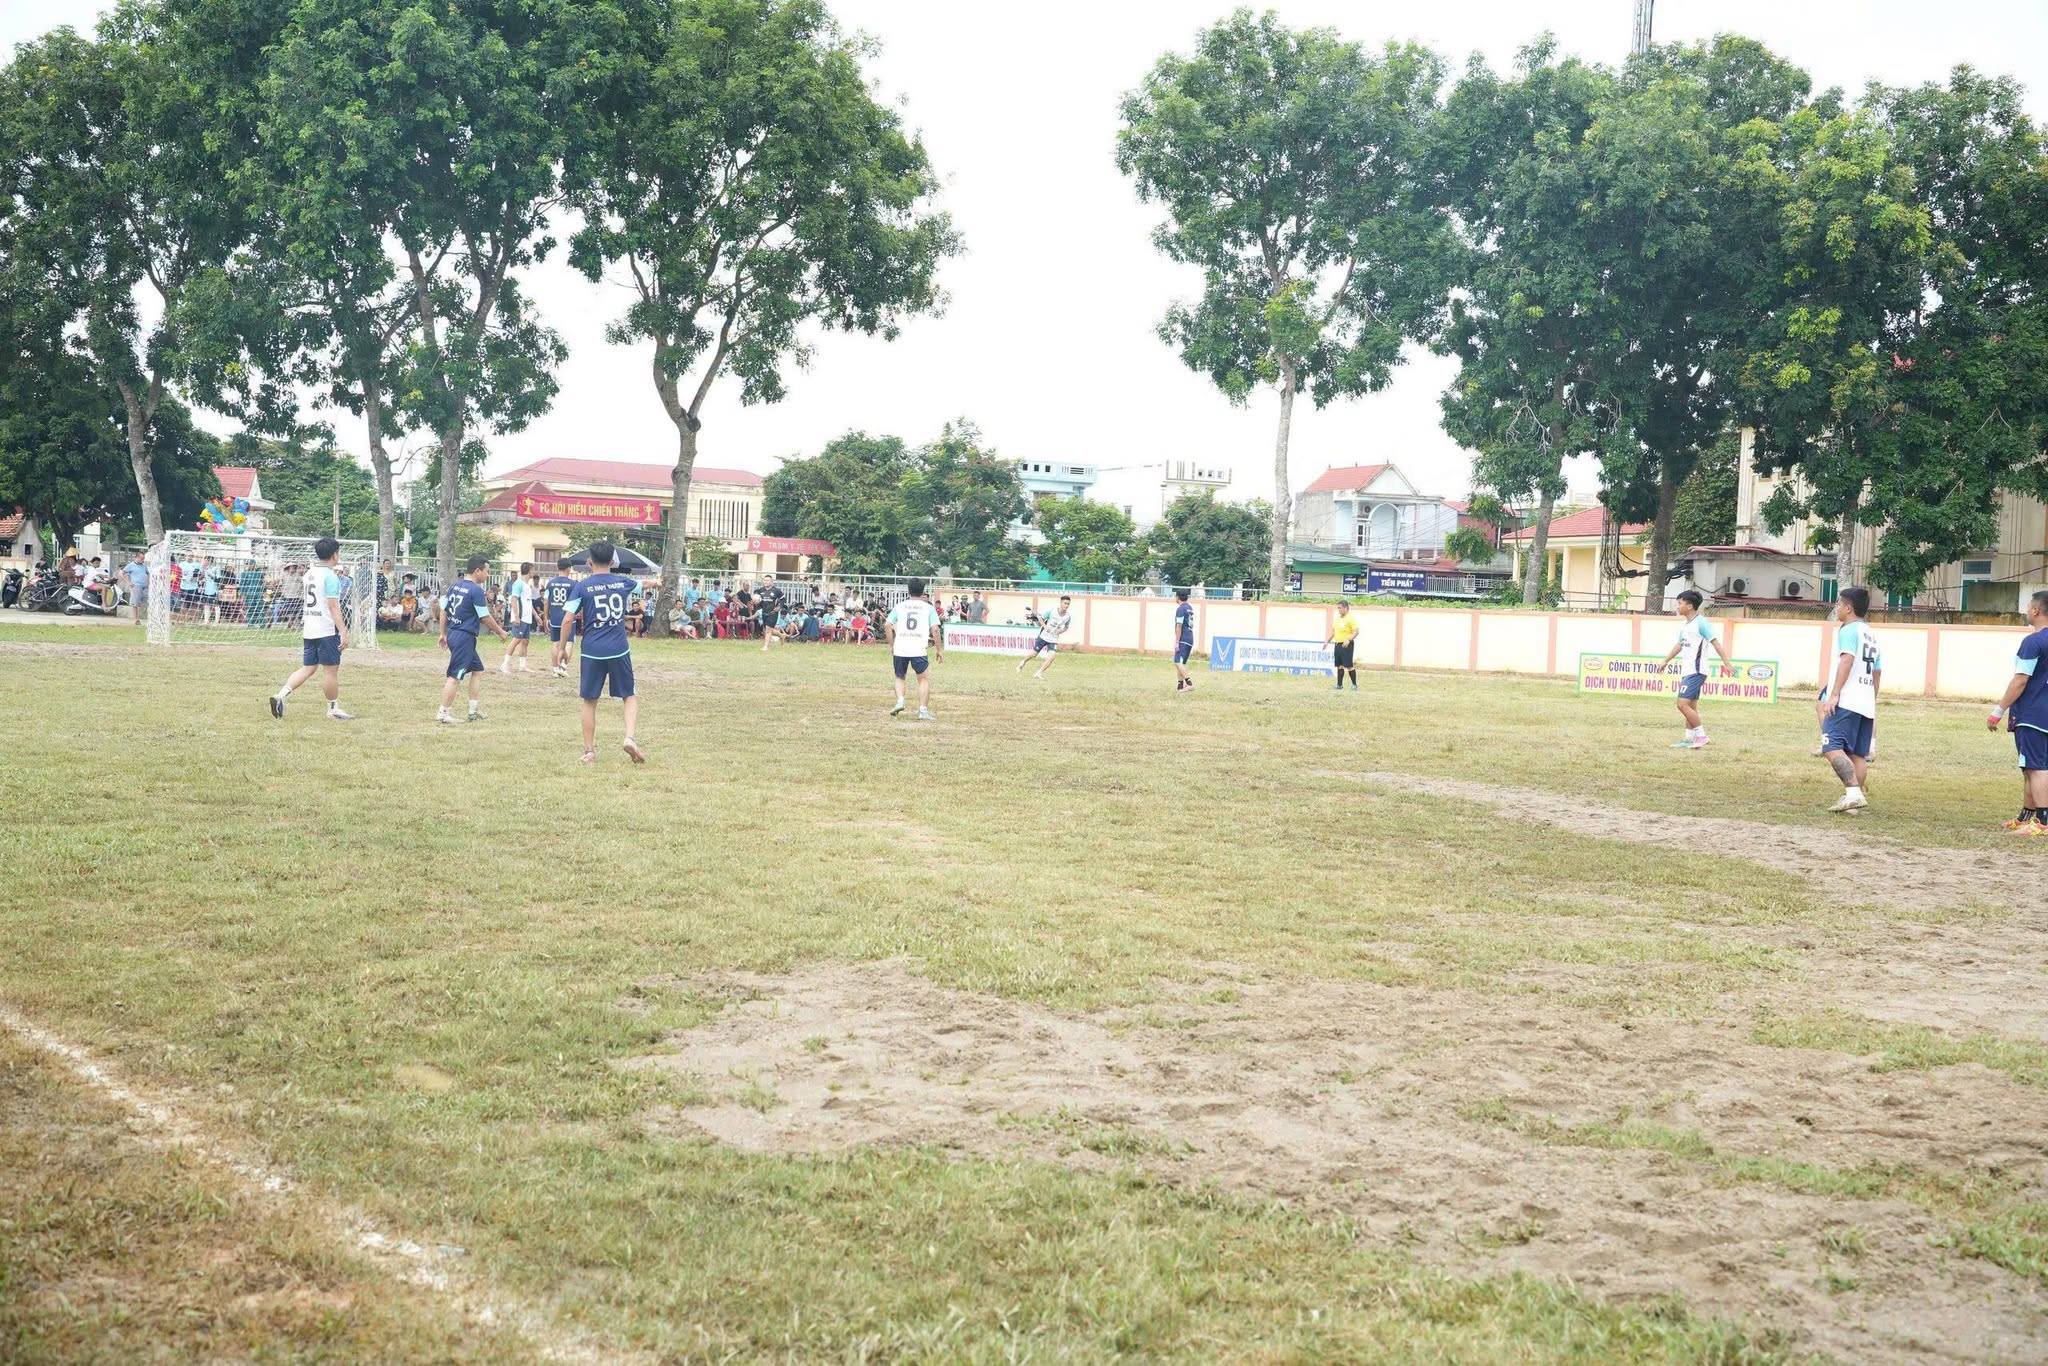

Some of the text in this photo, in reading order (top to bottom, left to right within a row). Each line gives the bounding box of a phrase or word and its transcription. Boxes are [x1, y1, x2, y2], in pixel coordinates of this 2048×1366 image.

[539, 501, 550, 514] FC
[553, 587, 567, 602] 98
[593, 592, 624, 622] 59
[906, 611, 918, 631] 6
[1608, 660, 1630, 672] CÔNG
[1632, 663, 1642, 673] TY
[1585, 676, 1604, 690] DỊCH
[1607, 678, 1618, 692] VỤ
[1722, 682, 1741, 696] HƠN
[1744, 682, 1769, 698] VÀNG
